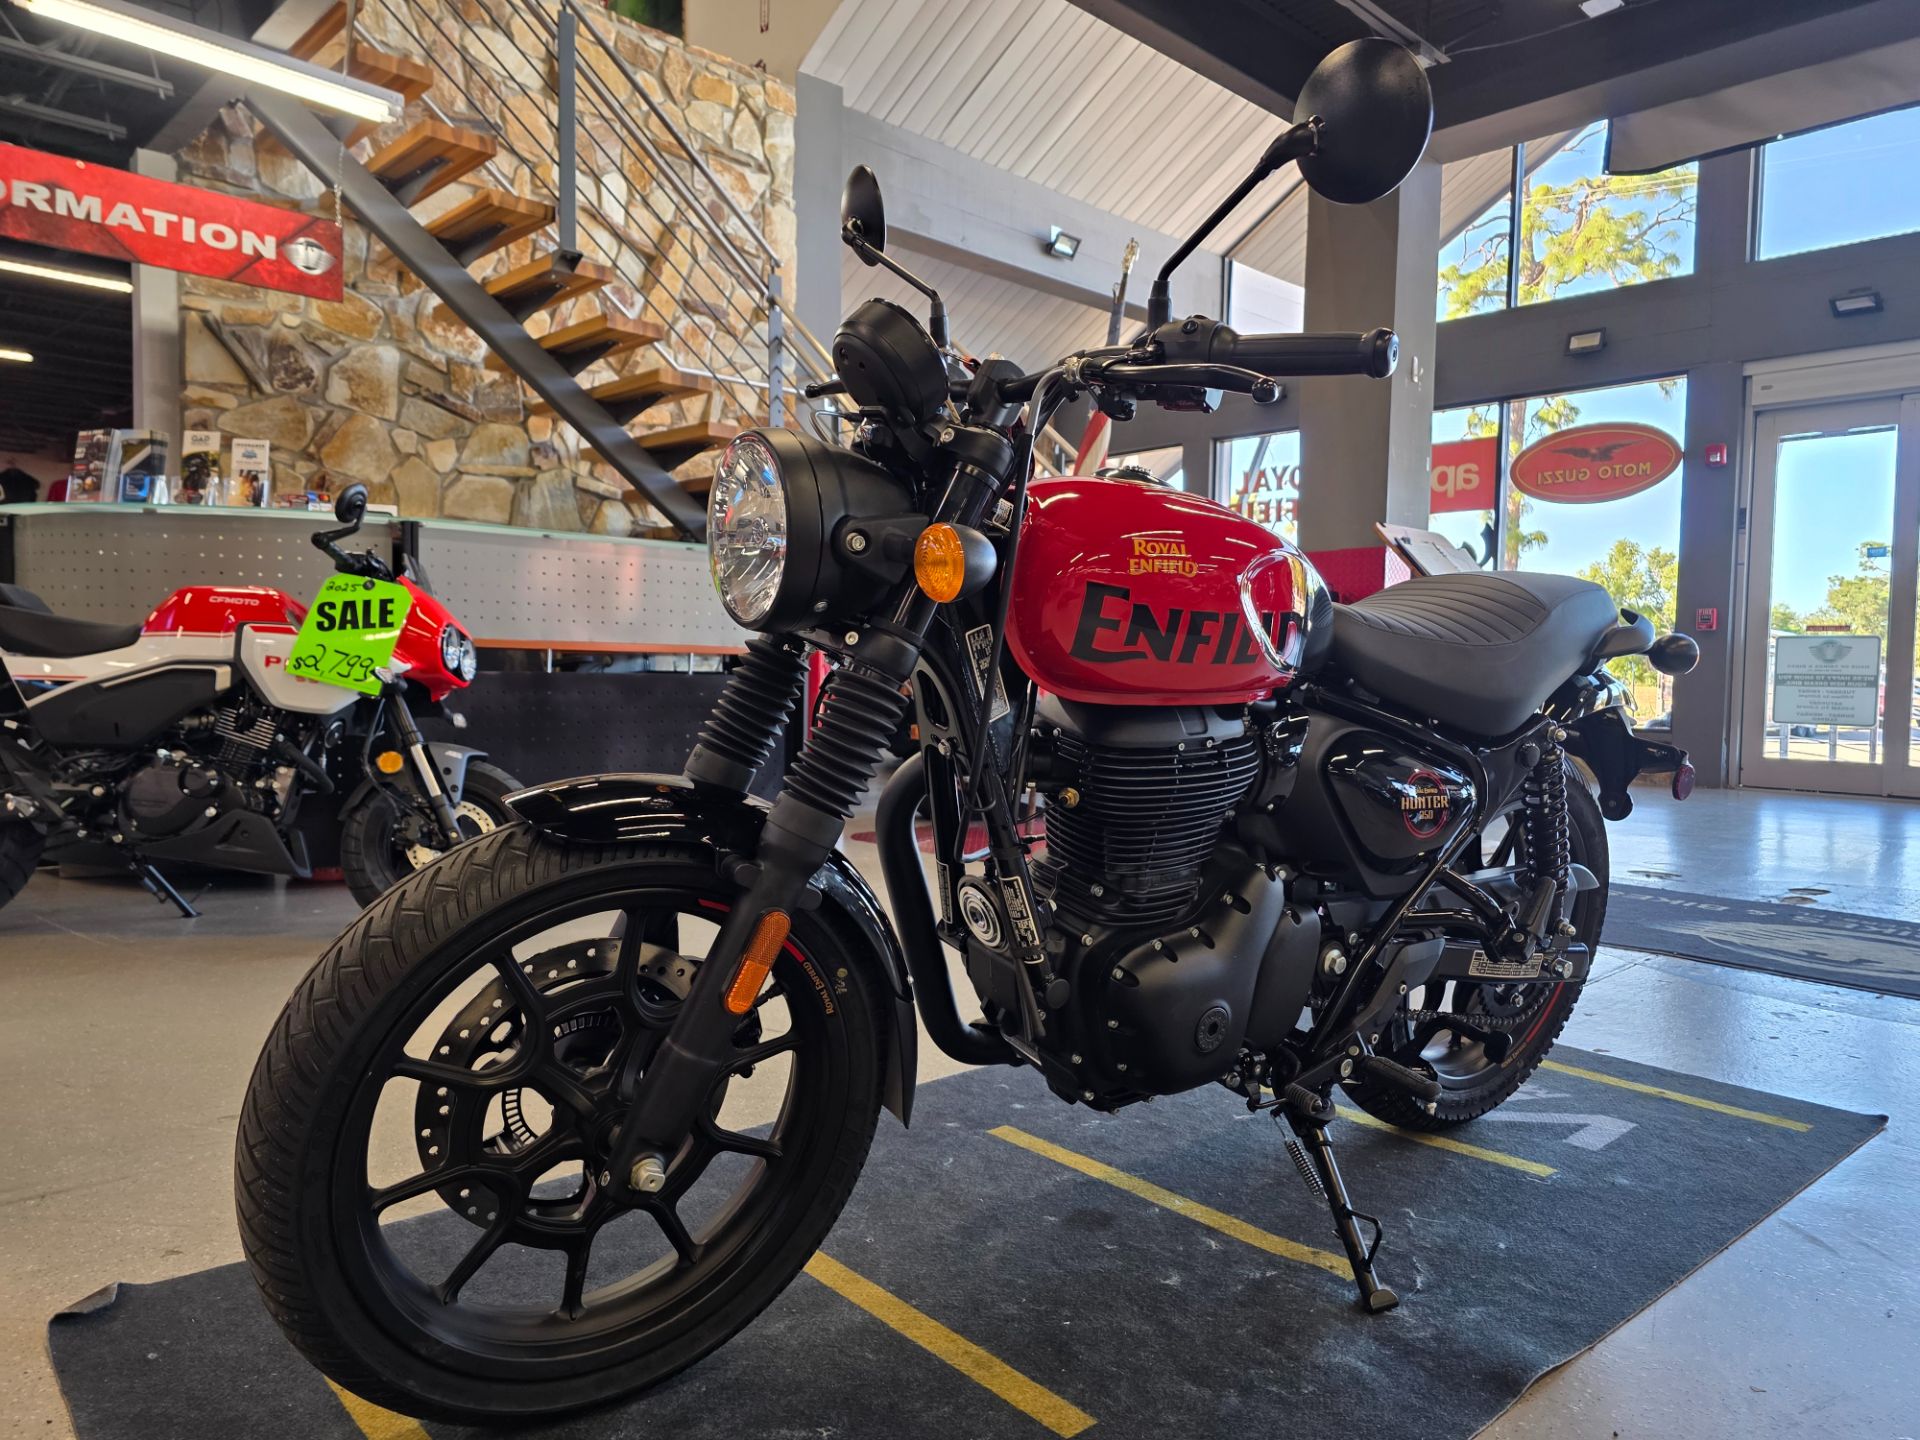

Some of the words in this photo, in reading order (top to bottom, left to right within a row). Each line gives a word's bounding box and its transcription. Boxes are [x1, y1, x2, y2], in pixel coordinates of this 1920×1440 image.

[0, 179, 277, 260] RMATION
[1134, 539, 1188, 556] ROYAL
[1129, 558, 1198, 577] ENFIELD
[326, 581, 357, 592] 2025
[209, 596, 260, 606] CFMOTO
[316, 598, 395, 632] SALE
[293, 644, 375, 682] $2,799
[1401, 795, 1449, 809] HUNTER
[820, 989, 835, 1014] ROYAL
